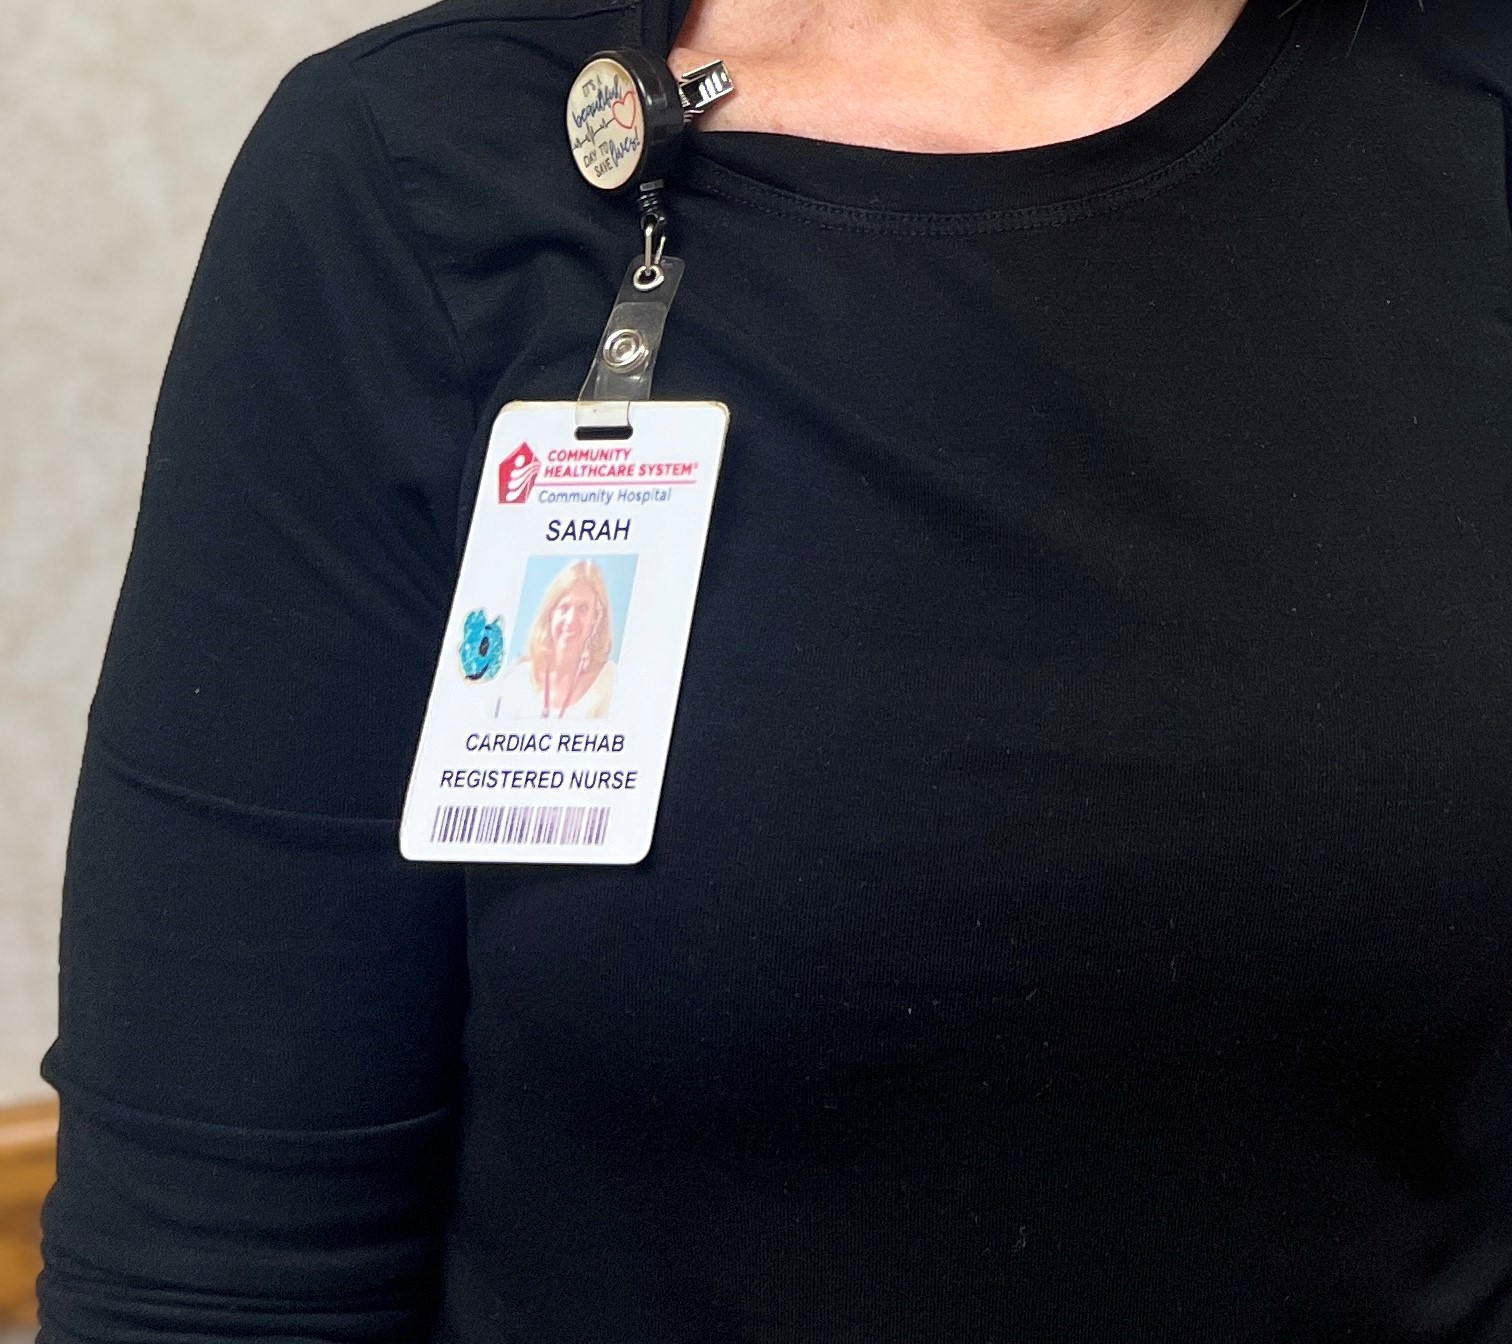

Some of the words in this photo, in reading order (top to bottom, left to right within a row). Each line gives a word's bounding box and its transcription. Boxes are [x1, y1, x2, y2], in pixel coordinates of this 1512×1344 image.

[547, 448, 632, 462] COMMUNITY
[543, 464, 634, 478] HEALTHCARE
[538, 489, 613, 505] Community
[617, 487, 672, 505] Hospital
[545, 518, 631, 542] SARAH
[465, 733, 552, 752] CARDIAC
[557, 734, 626, 752] REHAB
[440, 770, 564, 789] REGISTERED
[569, 770, 638, 790] NURSE
